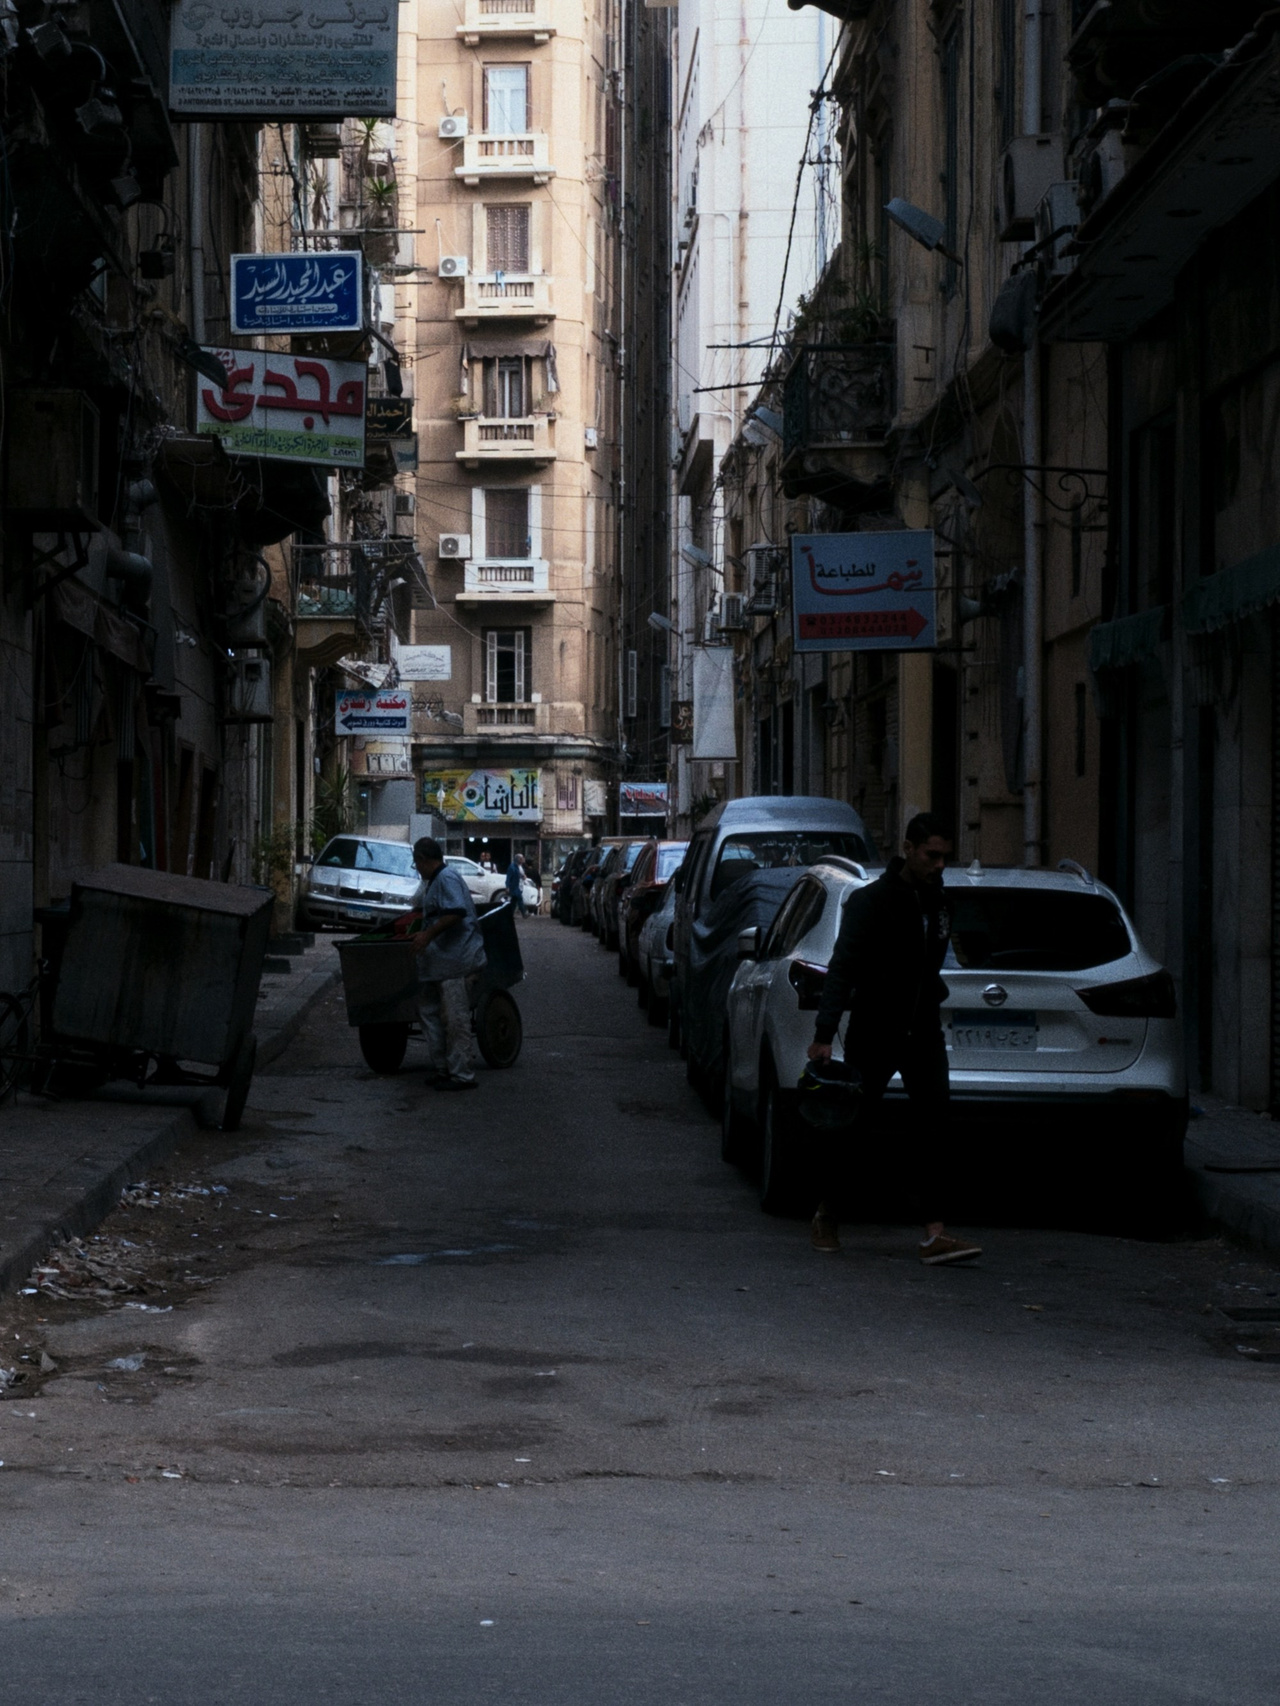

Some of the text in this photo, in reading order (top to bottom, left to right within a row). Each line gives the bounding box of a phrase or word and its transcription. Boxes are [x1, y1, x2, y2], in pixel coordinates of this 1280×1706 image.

[815, 563, 876, 582] للطباعة
[376, 694, 407, 713] مكتبة
[483, 774, 538, 815] الباشا
